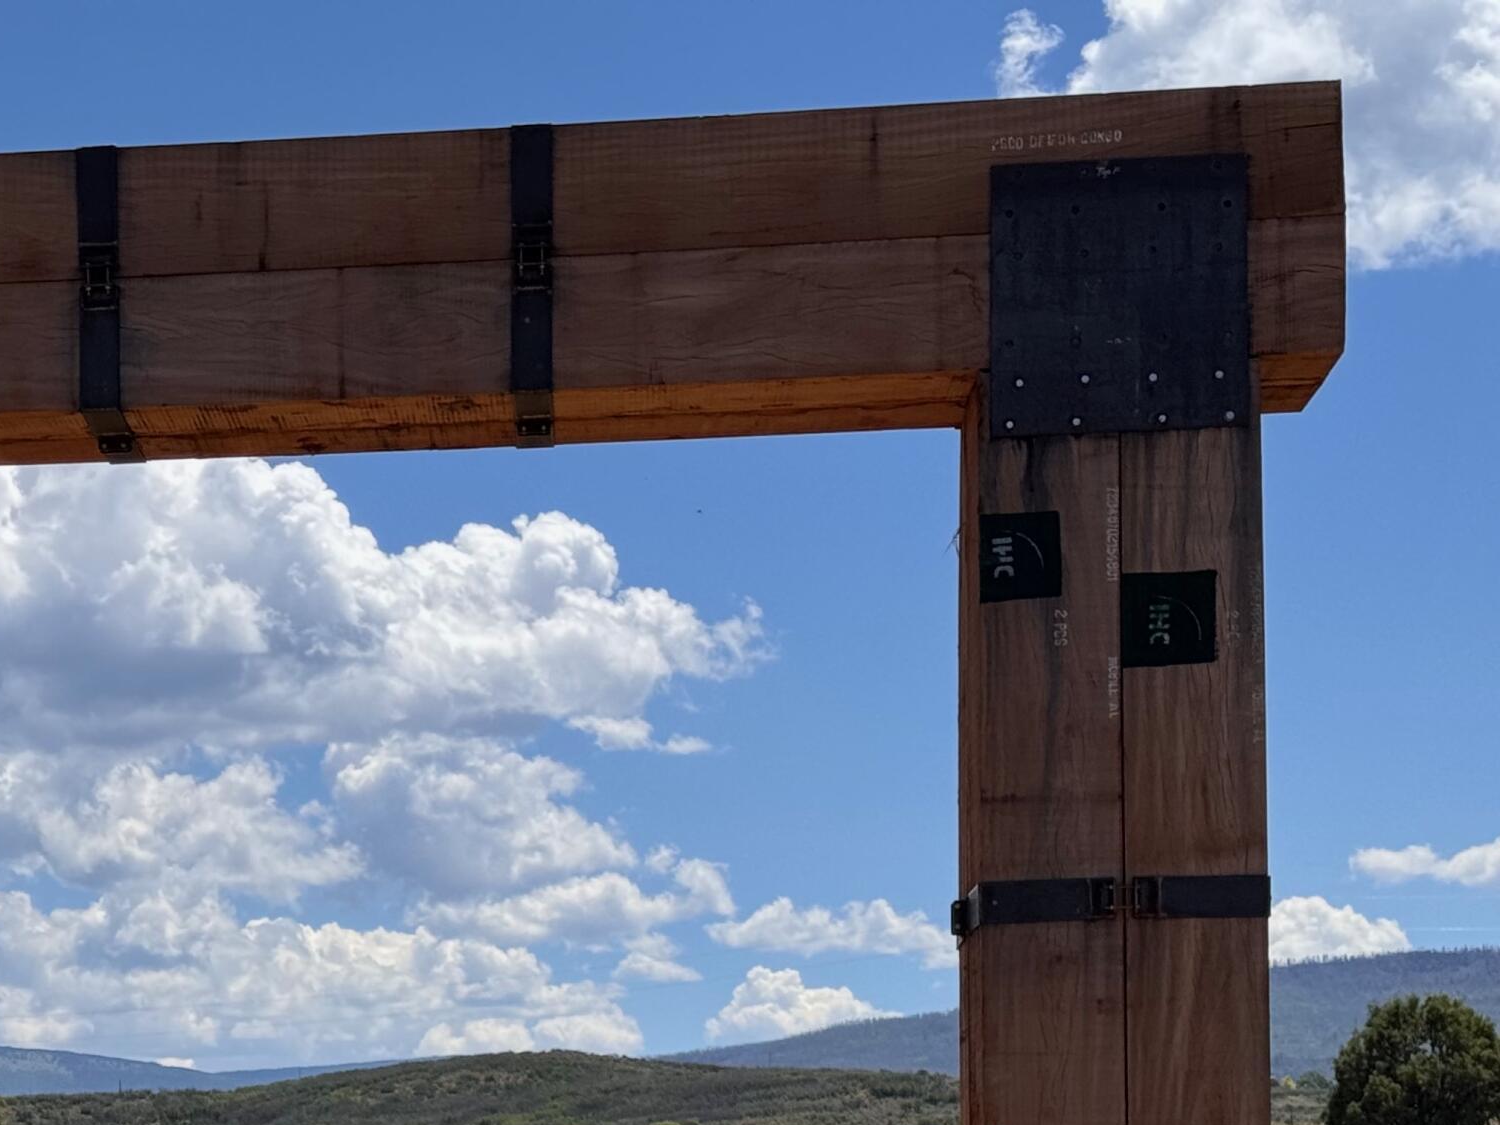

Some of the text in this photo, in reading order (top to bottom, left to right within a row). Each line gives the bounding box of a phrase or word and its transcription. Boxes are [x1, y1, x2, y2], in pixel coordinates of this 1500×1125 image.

[991, 536, 1015, 580] IHC
[1053, 609, 1068, 648] 2 PCS
[1149, 603, 1170, 646] IHC
